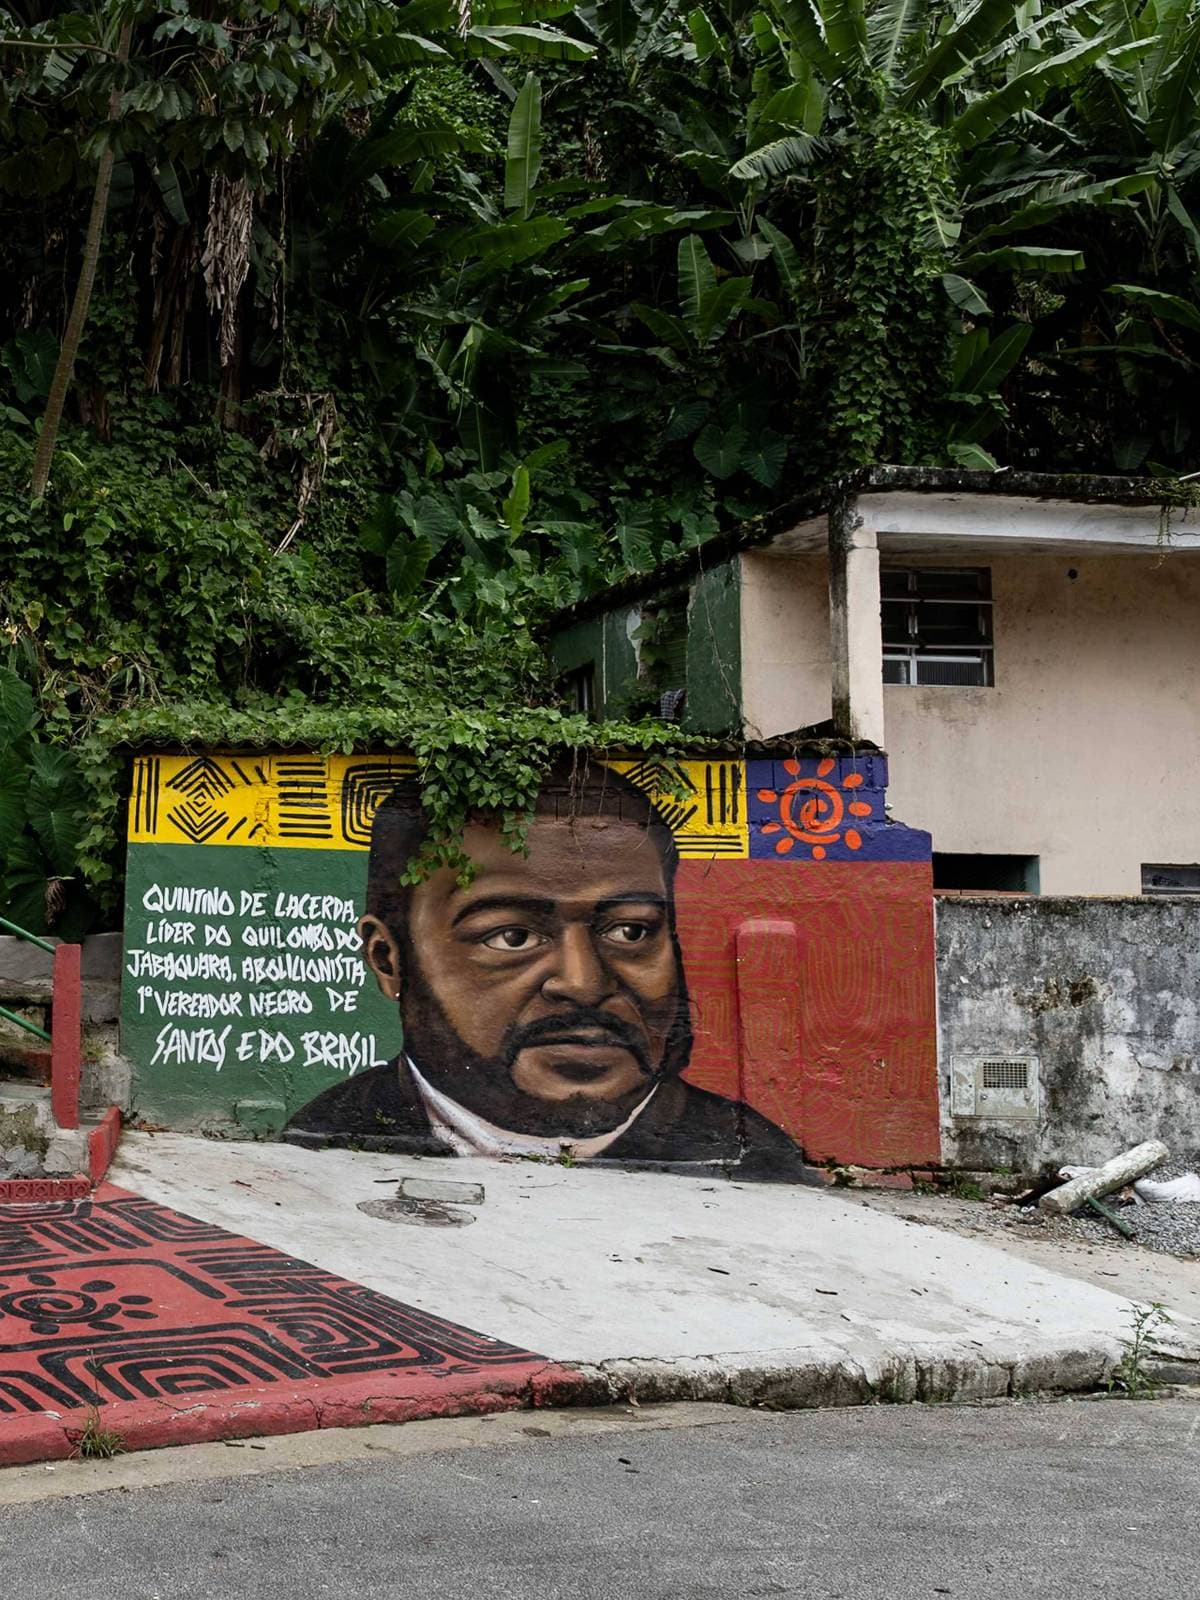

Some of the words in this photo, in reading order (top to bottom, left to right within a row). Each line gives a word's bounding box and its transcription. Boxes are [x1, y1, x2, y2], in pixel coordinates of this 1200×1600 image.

[142, 883, 235, 916] QUINTINO
[239, 890, 268, 917] DE
[274, 892, 359, 924] LACERDA,
[146, 918, 196, 945] LÍDER
[204, 925, 232, 947] DO
[126, 949, 237, 983] JABAQUARA,
[154, 990, 243, 1019] VEREADOR
[249, 989, 313, 1017] NEGRO
[325, 987, 359, 1012] DE
[150, 1022, 232, 1072] SANTOS
[300, 1030, 388, 1076] BRASIL
